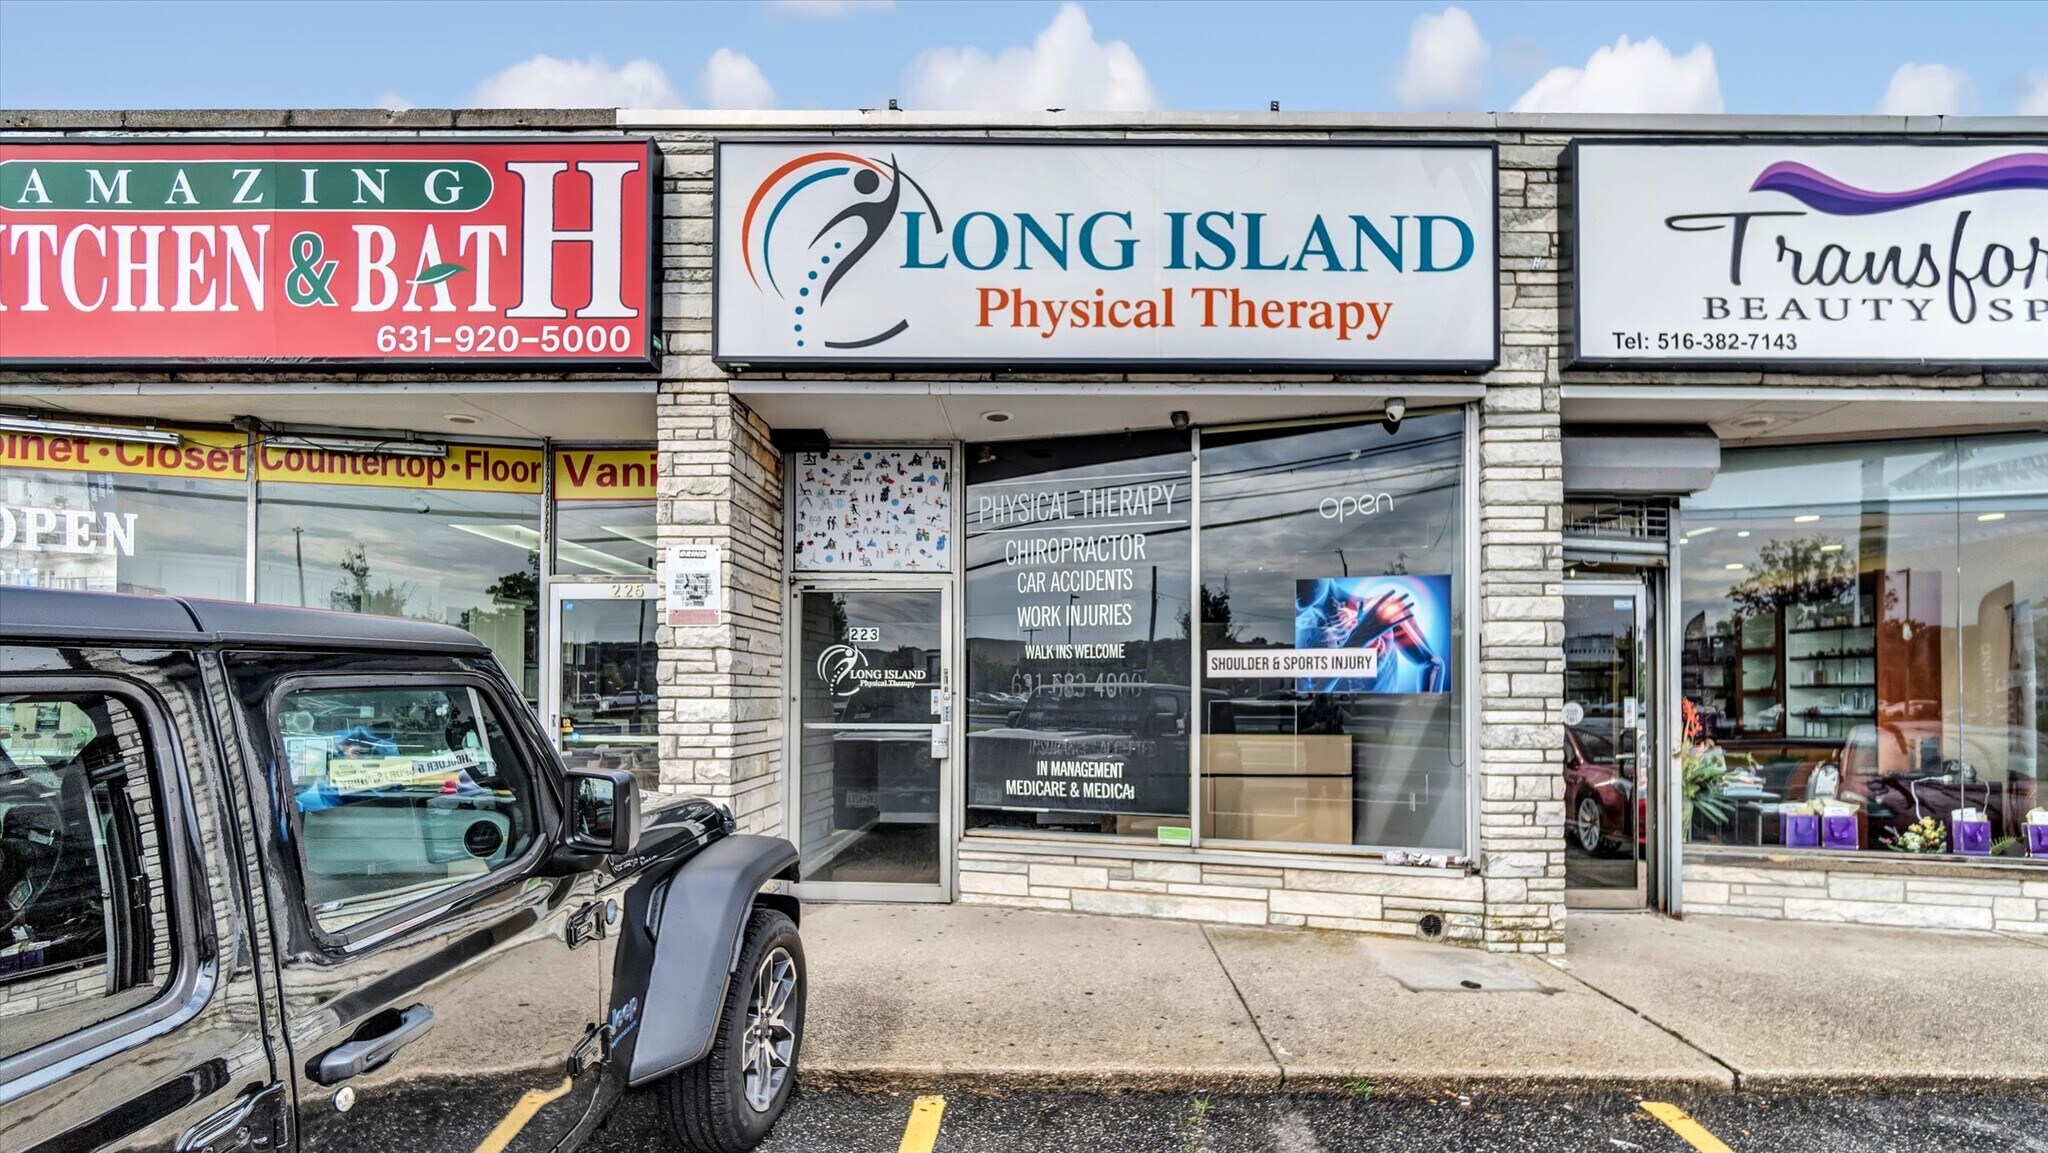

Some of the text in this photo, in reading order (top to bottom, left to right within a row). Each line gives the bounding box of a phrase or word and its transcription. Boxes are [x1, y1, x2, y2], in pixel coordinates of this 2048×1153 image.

[18, 167, 464, 205] AMAZING
[900, 210, 1475, 274] LONG ISLAND
[284, 229, 338, 308] &
[975, 286, 1393, 341] Physical Therapy
[1702, 296, 2048, 323] BEAUTY SP
[376, 325, 632, 354] 631-920-5000
[1612, 331, 1798, 351] Tel: 516-382-7143
[0, 433, 246, 474] inet Closet
[259, 444, 542, 486] Countertop Floor
[978, 483, 1178, 525] PHYSICAL THERAPY
[1319, 492, 1395, 523] open
[1004, 533, 1147, 566] CHIROPRACTOR
[611, 584, 645, 598] 225
[1016, 568, 1134, 594] CAR ACCIDENTS
[1016, 603, 1133, 628] WORK INJURIES
[850, 628, 878, 641] 223
[1024, 643, 1126, 660] WALK INS WELCOME
[1211, 654, 1373, 672] SHOULDER & SPORTS INJURY
[850, 669, 927, 680] LONG ISLAND
[860, 680, 916, 689] Physical Therapy
[1036, 760, 1125, 779] IN MANAGEMENT
[1005, 779, 1067, 798] MEDICARE
[1070, 781, 1080, 798] &
